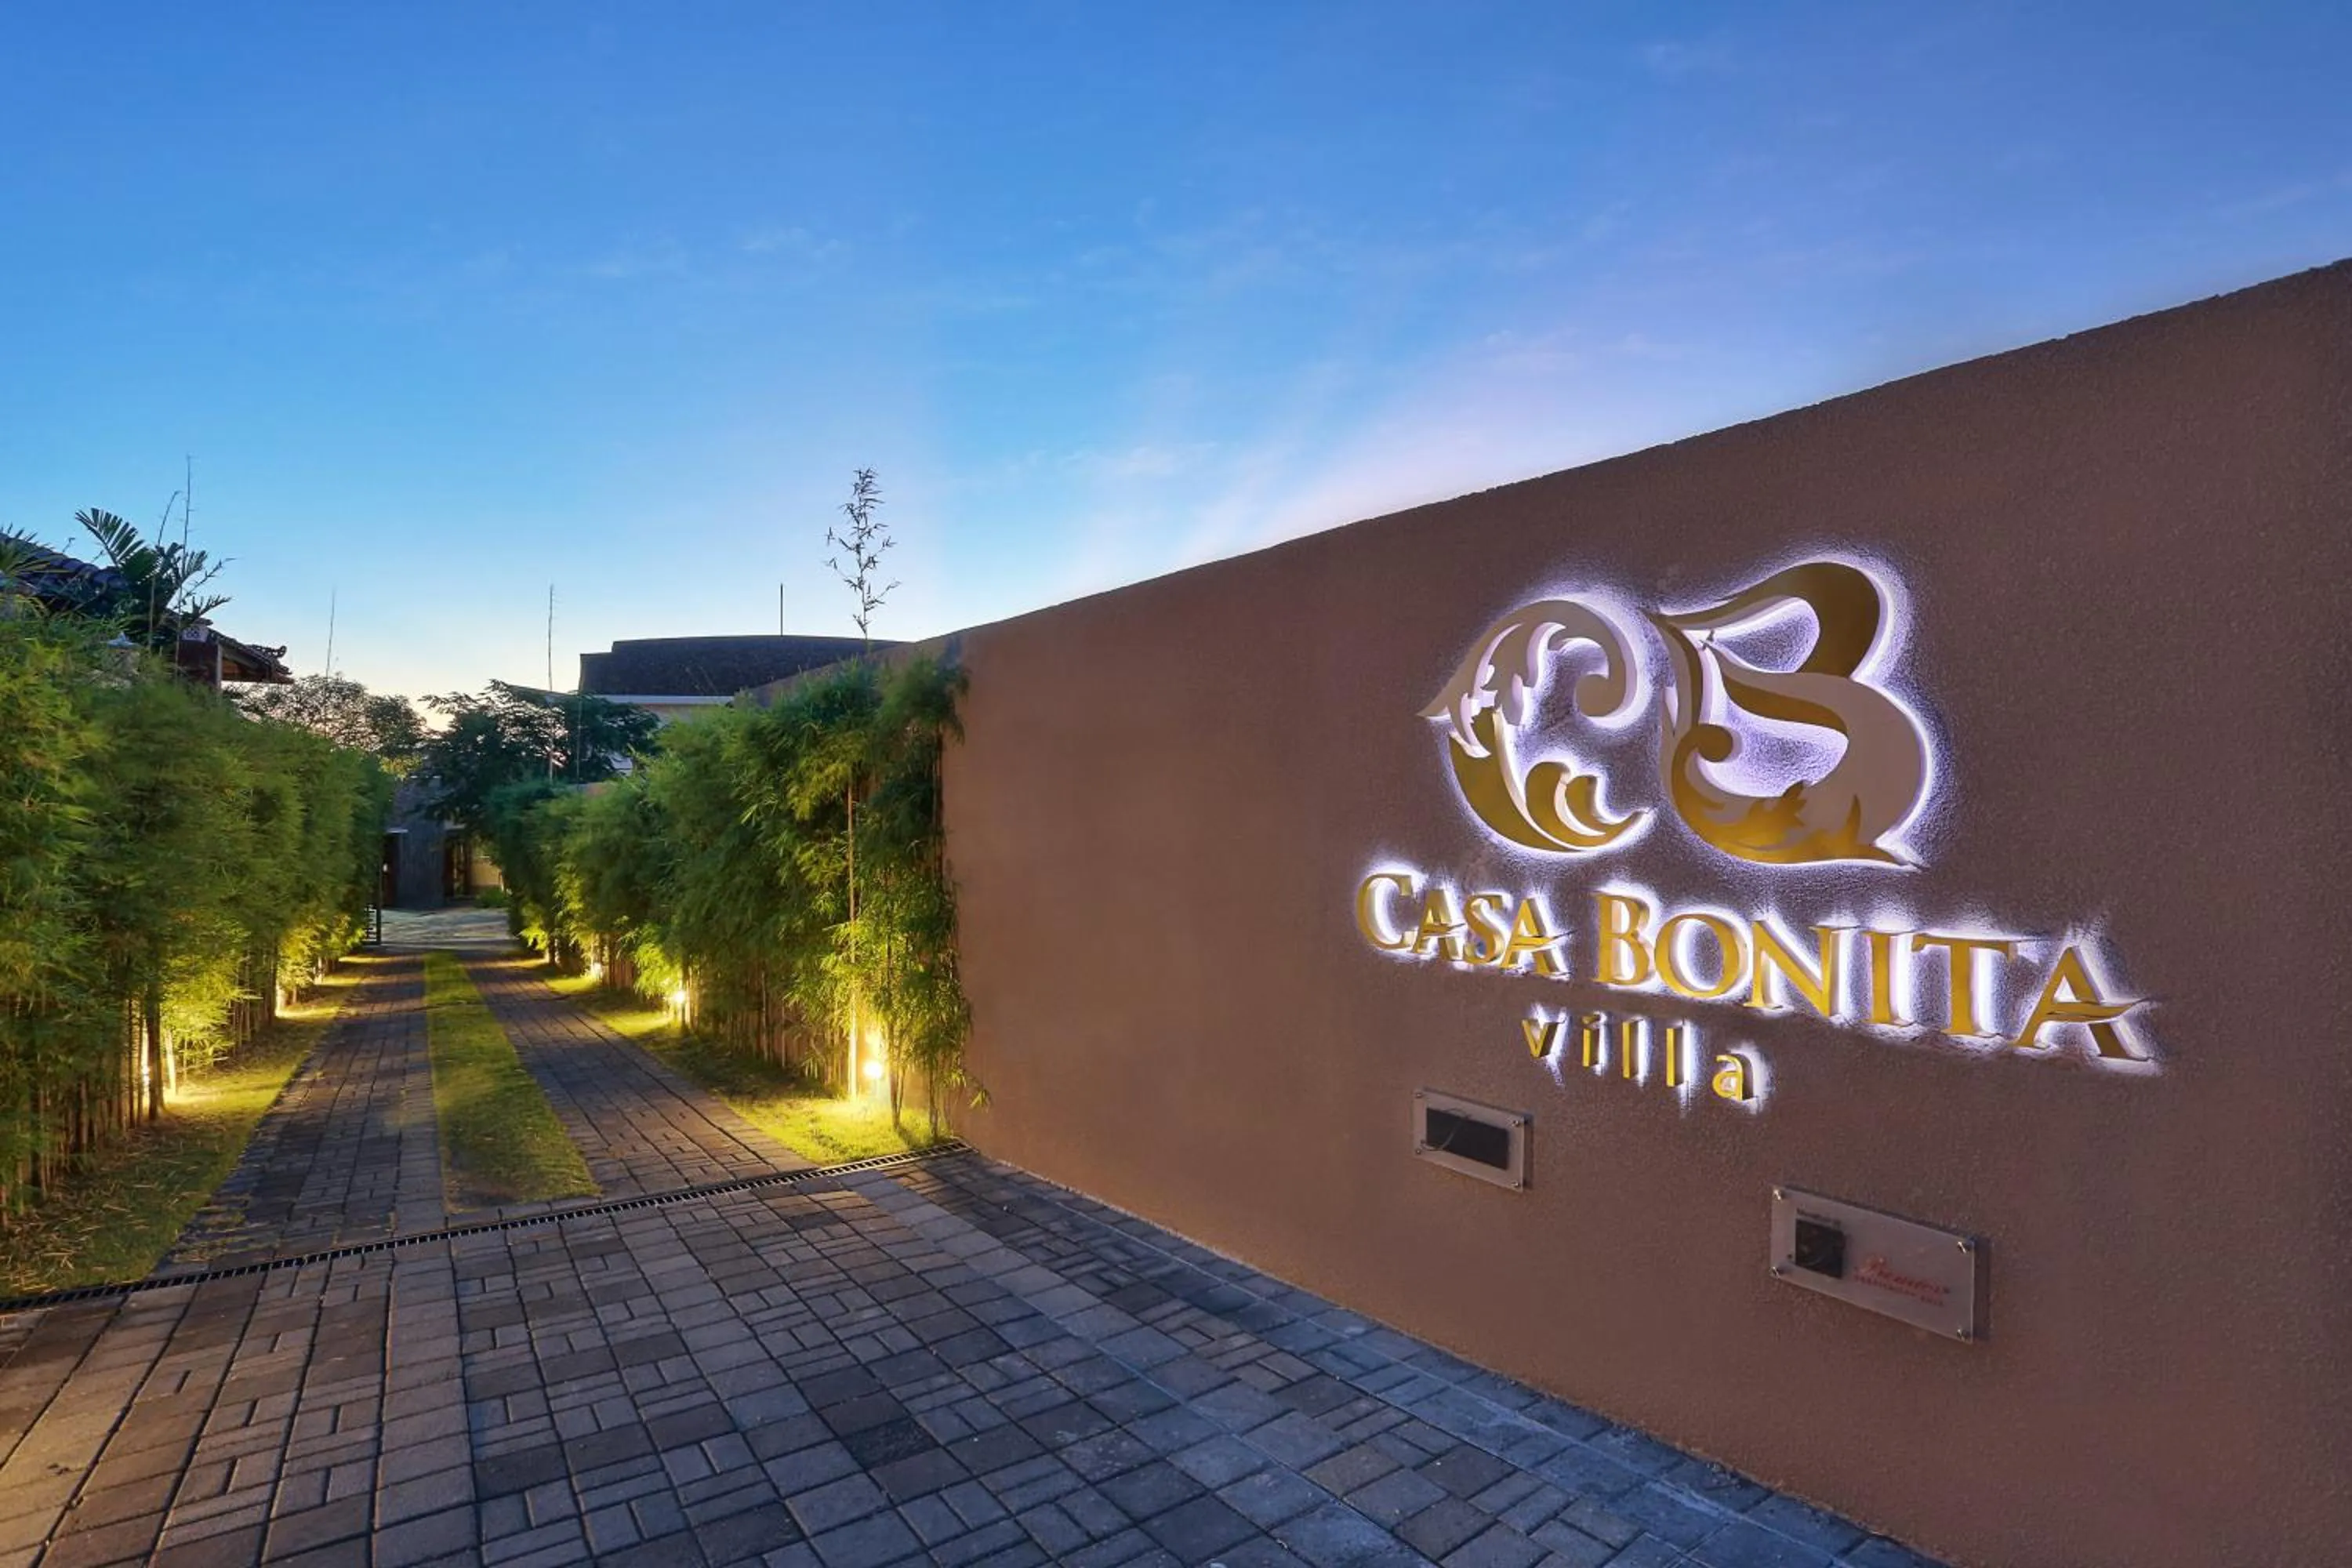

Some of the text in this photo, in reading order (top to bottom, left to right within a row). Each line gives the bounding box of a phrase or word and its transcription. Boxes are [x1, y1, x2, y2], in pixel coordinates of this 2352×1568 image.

[1356, 873, 2150, 1061] CASA BONITA
[1522, 1016, 1756, 1102] villa
